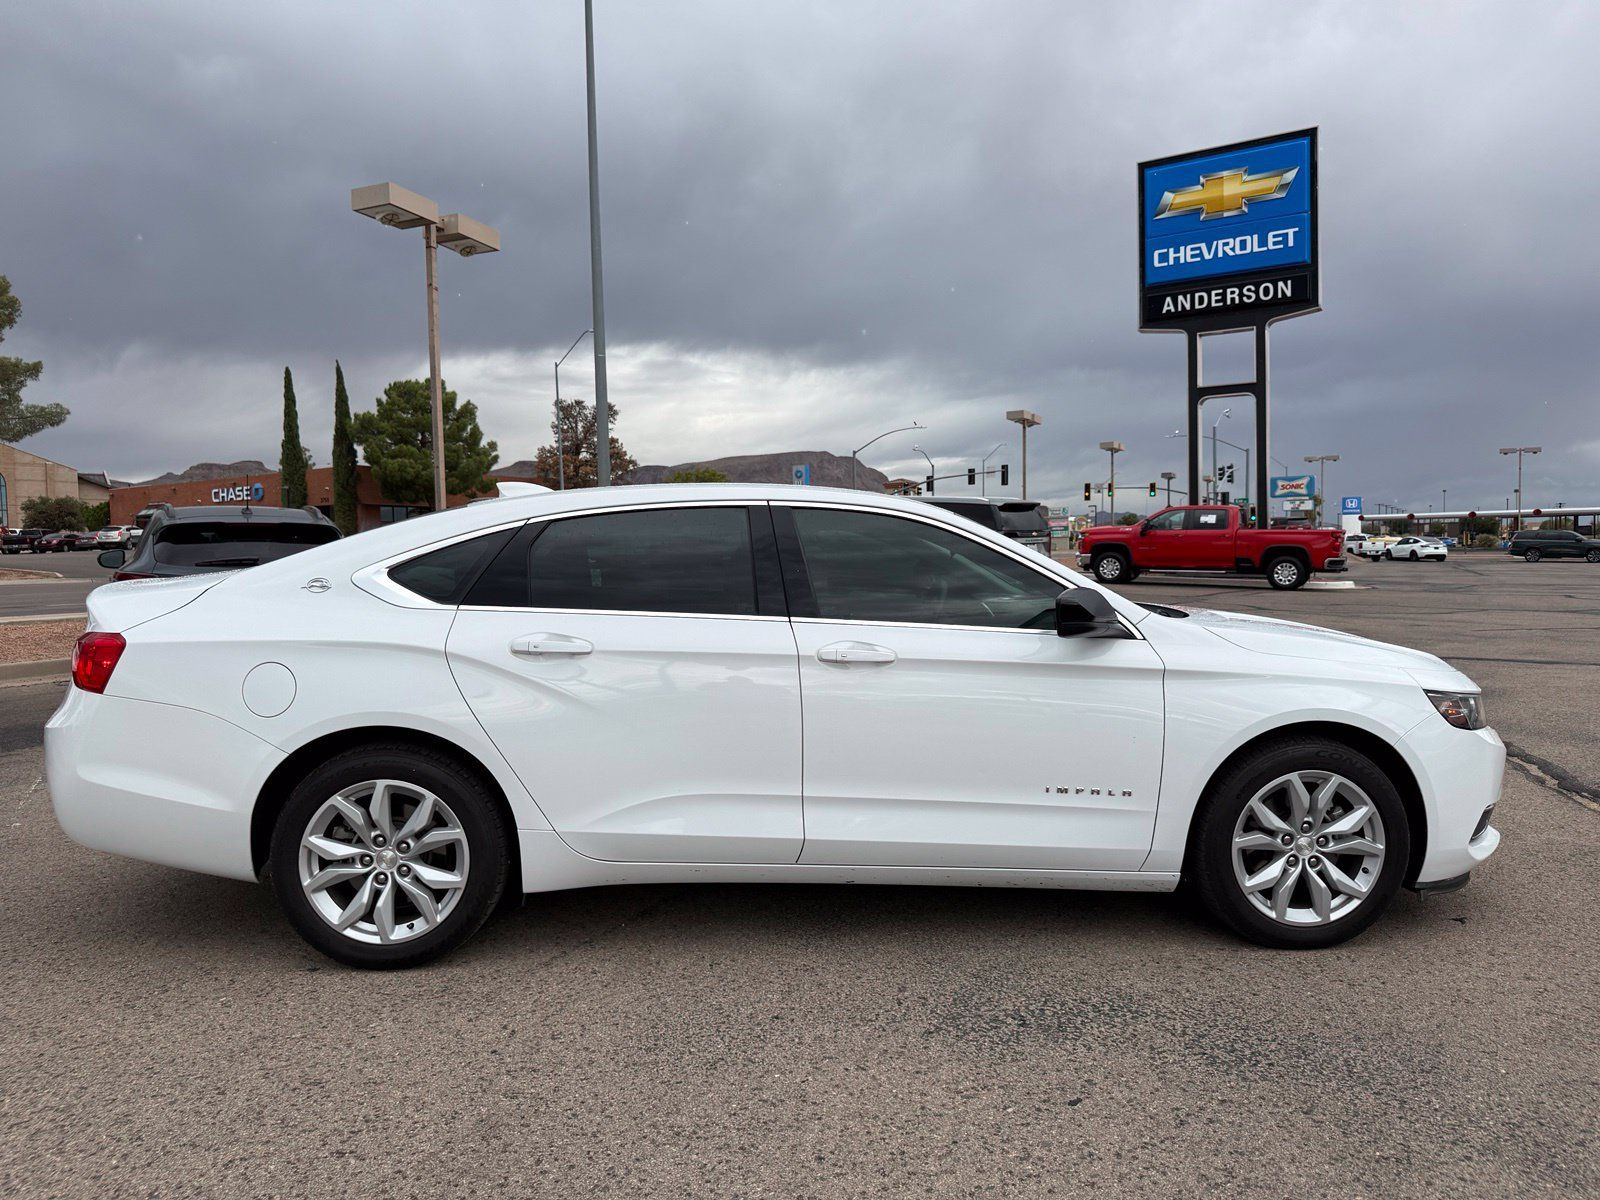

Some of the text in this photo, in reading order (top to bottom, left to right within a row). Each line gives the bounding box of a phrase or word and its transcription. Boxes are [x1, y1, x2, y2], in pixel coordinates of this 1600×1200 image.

[1153, 227, 1299, 268] CHEVROLET
[1161, 280, 1292, 314] ANDERSON
[211, 486, 251, 503] CHASE
[1045, 785, 1132, 797] IMPALA
